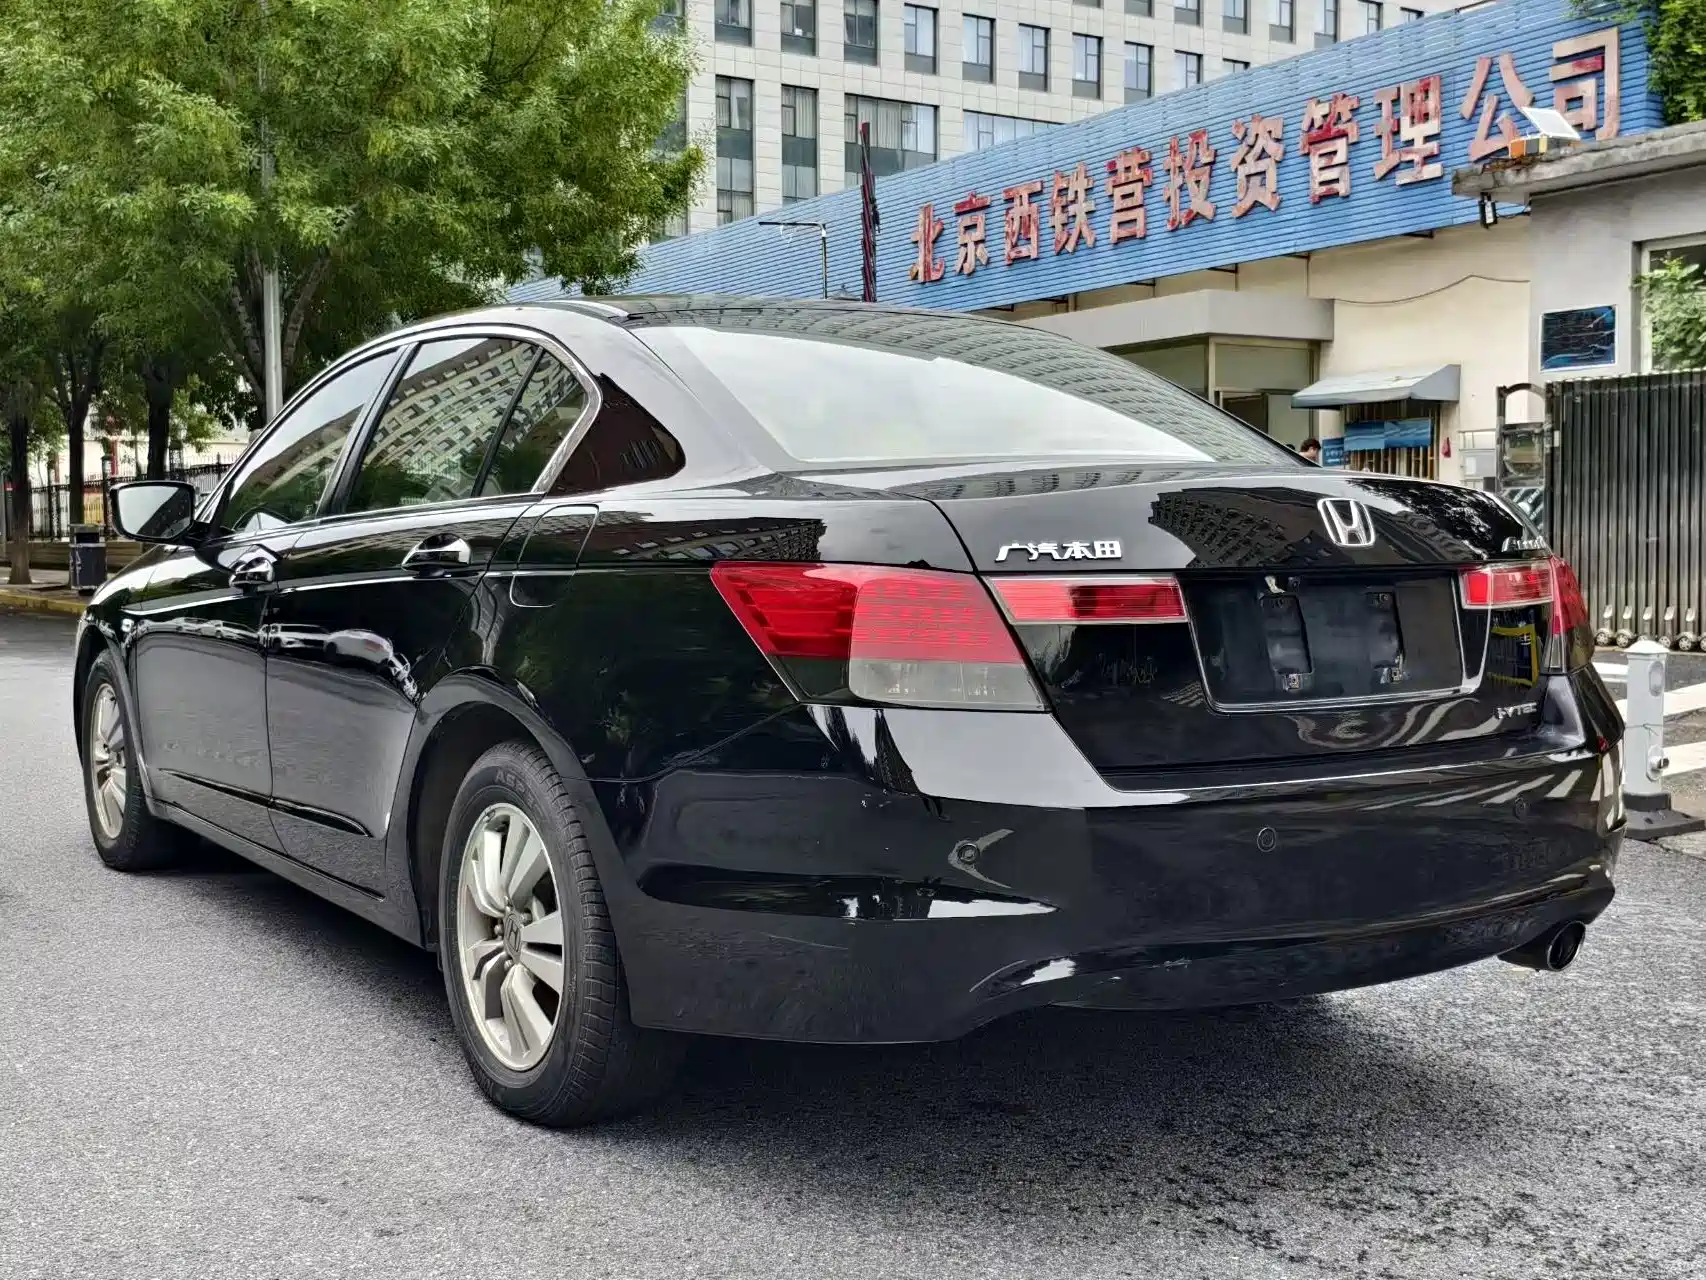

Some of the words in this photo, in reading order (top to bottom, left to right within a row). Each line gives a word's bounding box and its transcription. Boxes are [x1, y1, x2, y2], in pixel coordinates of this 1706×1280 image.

[908, 27, 1620, 283] 北京西铁营投资管理公司
[995, 540, 1122, 562] 广汽本田
